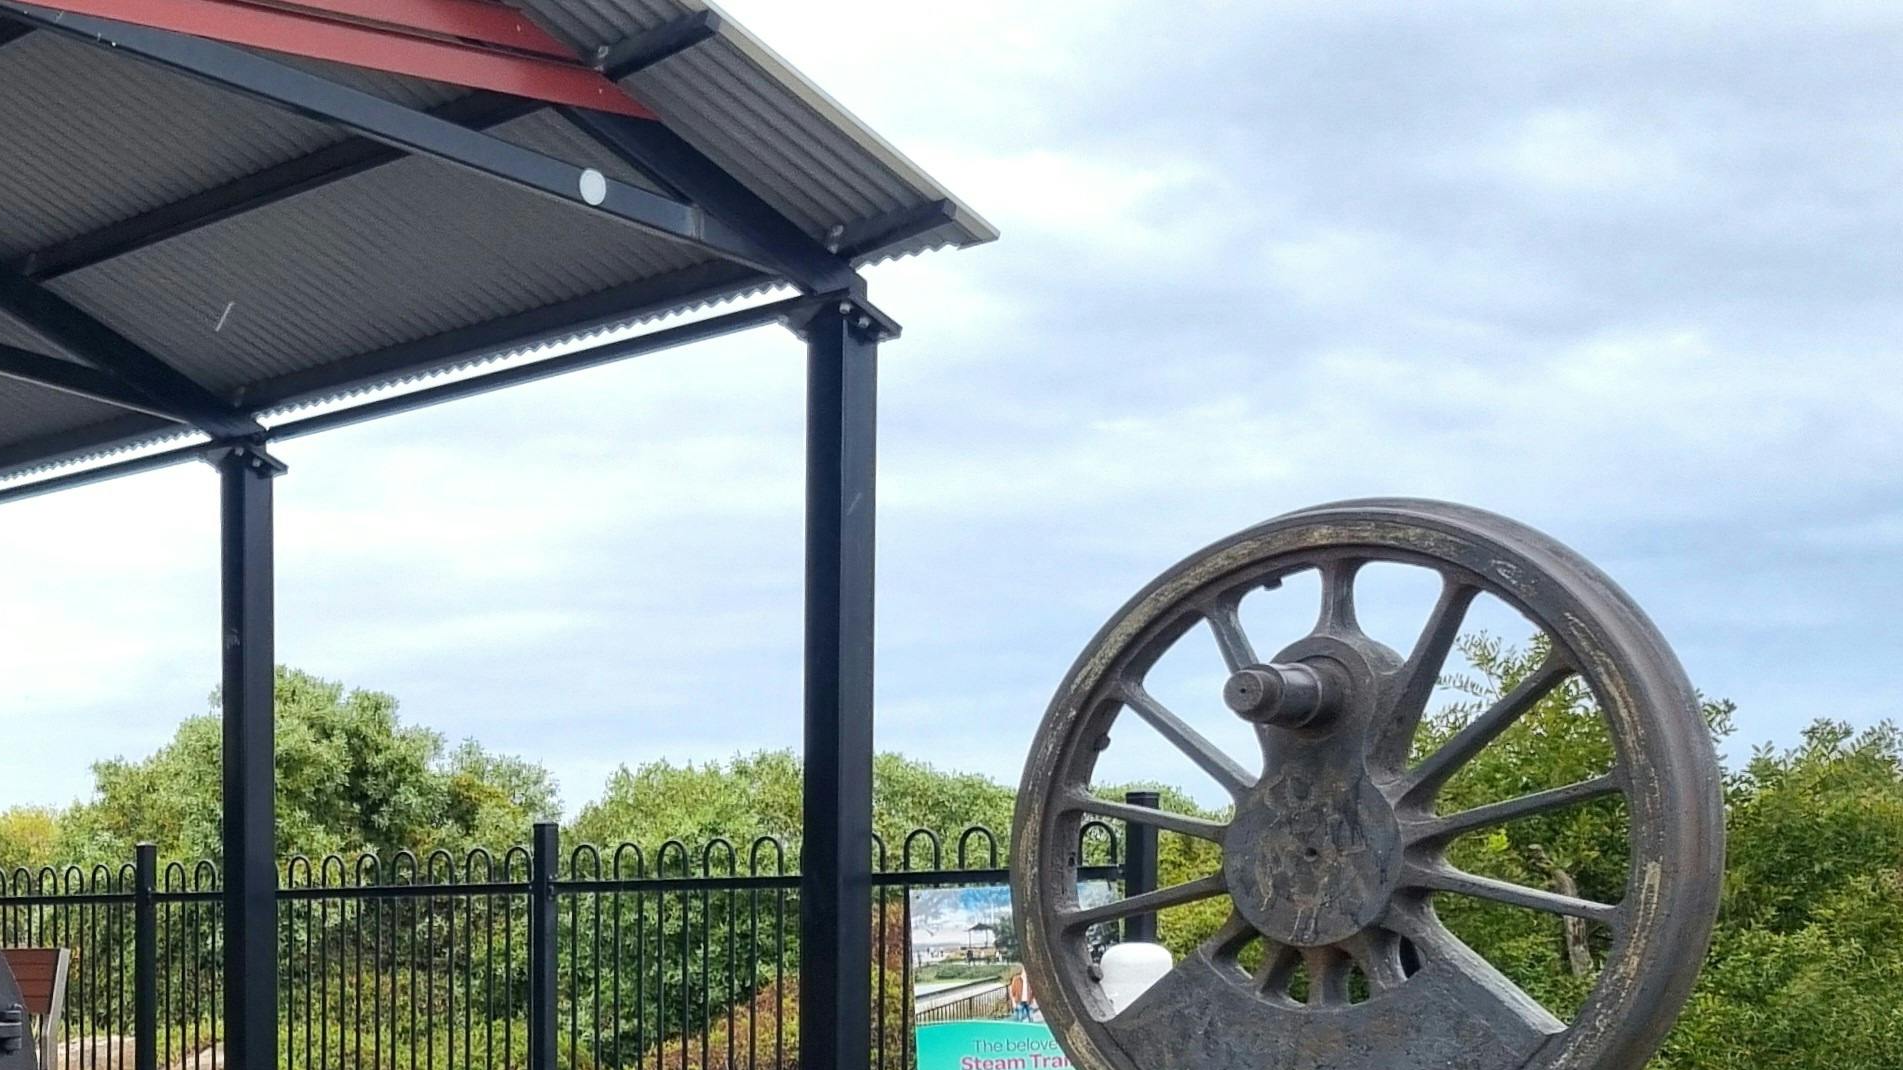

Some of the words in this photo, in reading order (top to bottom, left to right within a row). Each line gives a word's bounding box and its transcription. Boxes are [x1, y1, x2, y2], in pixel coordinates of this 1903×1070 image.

[974, 1039, 1003, 1053] The
[1006, 1038, 1057, 1052] belove
[1030, 1054, 1071, 1069] Trai
